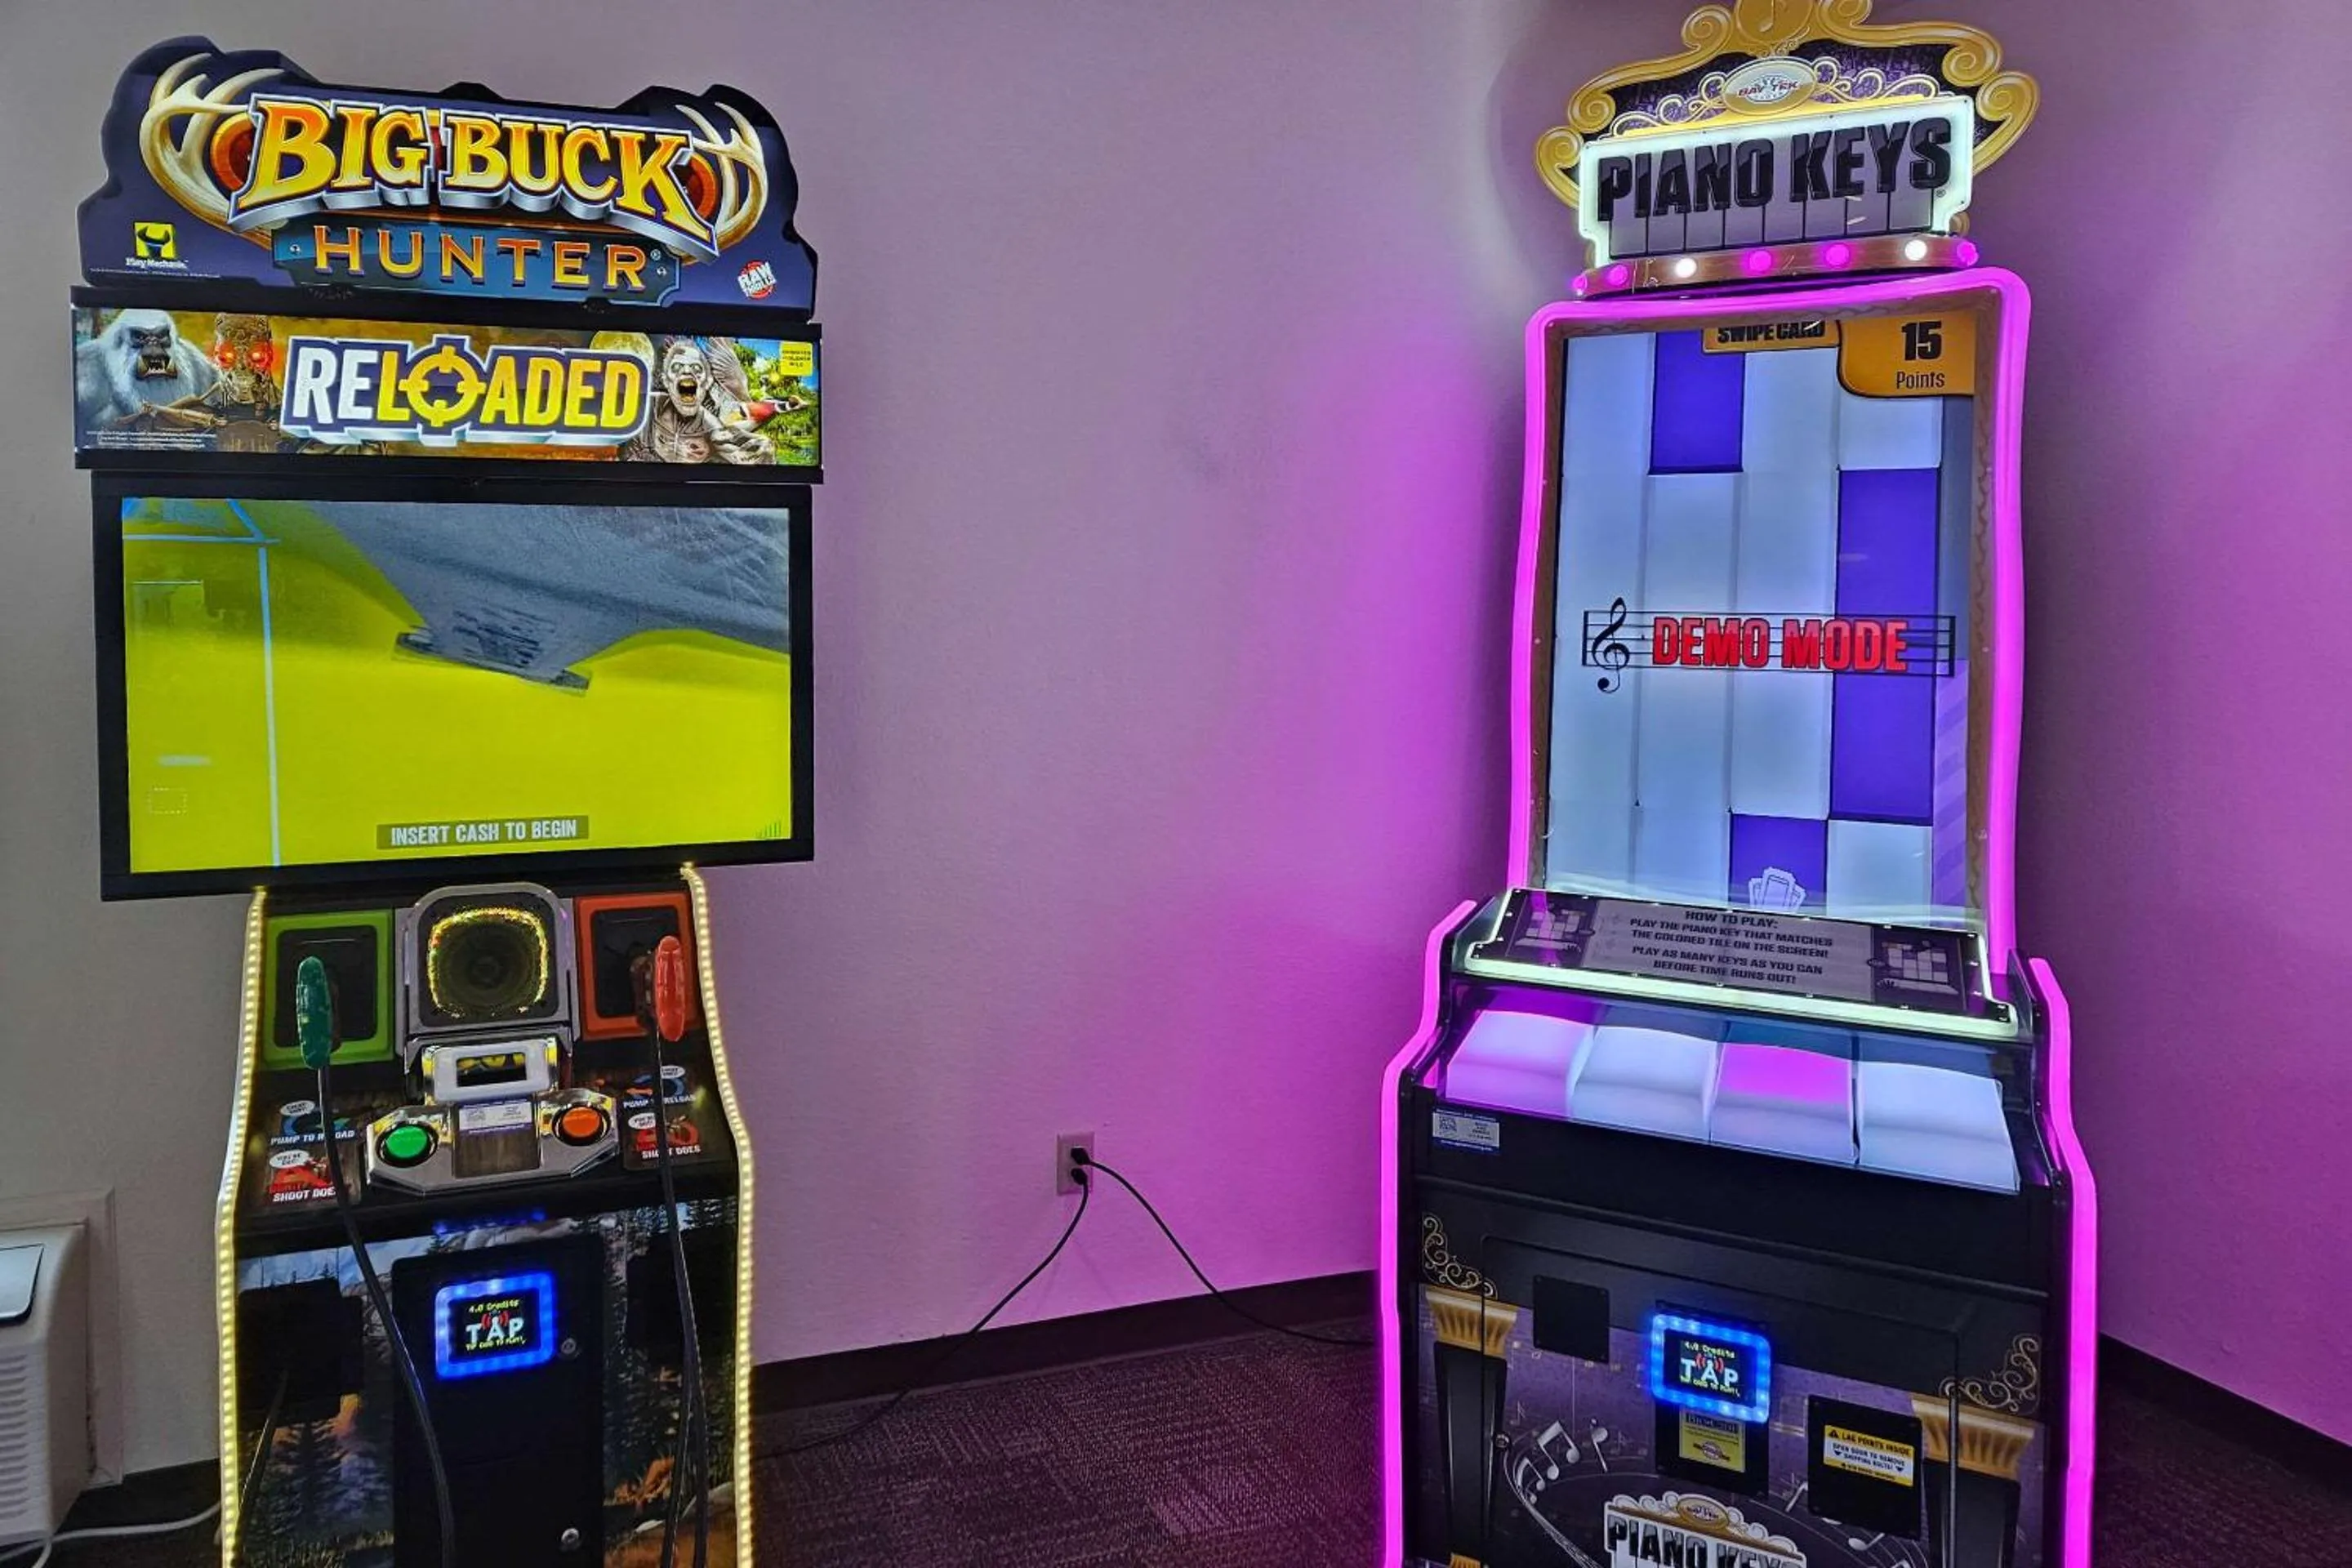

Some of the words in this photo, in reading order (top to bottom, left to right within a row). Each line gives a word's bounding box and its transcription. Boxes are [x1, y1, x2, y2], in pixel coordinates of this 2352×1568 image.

[238, 97, 430, 211] BIG
[446, 116, 713, 243] BUCK
[1597, 139, 1775, 222] PIANO
[1790, 117, 1953, 203] KEYS
[314, 225, 648, 289] HUNTER
[1717, 324, 1774, 344] SWIPE
[1901, 321, 1943, 361] 15
[292, 344, 649, 429] RELOADED
[1896, 370, 1945, 390] Points
[1652, 616, 1771, 669] DEMO
[1782, 618, 1908, 672] MODE
[391, 826, 449, 845] INSERT
[456, 823, 500, 843] CASH
[505, 822, 526, 840] TO
[532, 819, 577, 838] BEGIN
[1630, 918, 1657, 928] PLAY
[1659, 921, 1679, 931] THE
[1682, 924, 1716, 934] PIANO
[1719, 928, 1740, 937] KEY
[1744, 930, 1774, 941] THAT
[1775, 934, 1833, 947] MATCHES
[1685, 911, 1716, 922] HOW
[1722, 913, 1738, 924] TO
[1741, 916, 1779, 929] PLAY:
[1633, 929, 1651, 938] THE
[1655, 932, 1706, 944] COLORED
[1708, 938, 1731, 947] TILE
[1734, 941, 1751, 949] ON
[1753, 942, 1775, 953] THE
[1777, 945, 1829, 958] SCREEN!
[1633, 946, 1659, 956] PLAY
[1662, 950, 1677, 959] AS
[1680, 951, 1715, 963] MANY
[1717, 956, 1748, 966] KEYS
[1750, 960, 1766, 969] AS
[1771, 962, 1794, 972] YOU
[1797, 964, 1822, 974] CAN
[1654, 960, 1697, 973] BEFORE
[1700, 965, 1728, 976] TIME
[1731, 968, 1764, 979] RUNS
[1766, 973, 1796, 984] OUT!
[623, 1099, 649, 1108] PUMP
[271, 1136, 300, 1145] PUMP
[304, 1134, 314, 1143] TO
[273, 1189, 311, 1202] SHOOT
[466, 1316, 524, 1345] TAP
[1681, 1356, 1739, 1388] TAP
[1833, 1442, 1850, 1452] OPEN
[1879, 1454, 1905, 1466] REMOVE
[1843, 1453, 1872, 1465] SHIPPING
[1857, 1437, 1884, 1450] POINTS
[1886, 1443, 1909, 1455] INSIDE
[1607, 1514, 1708, 1568] PIANO
